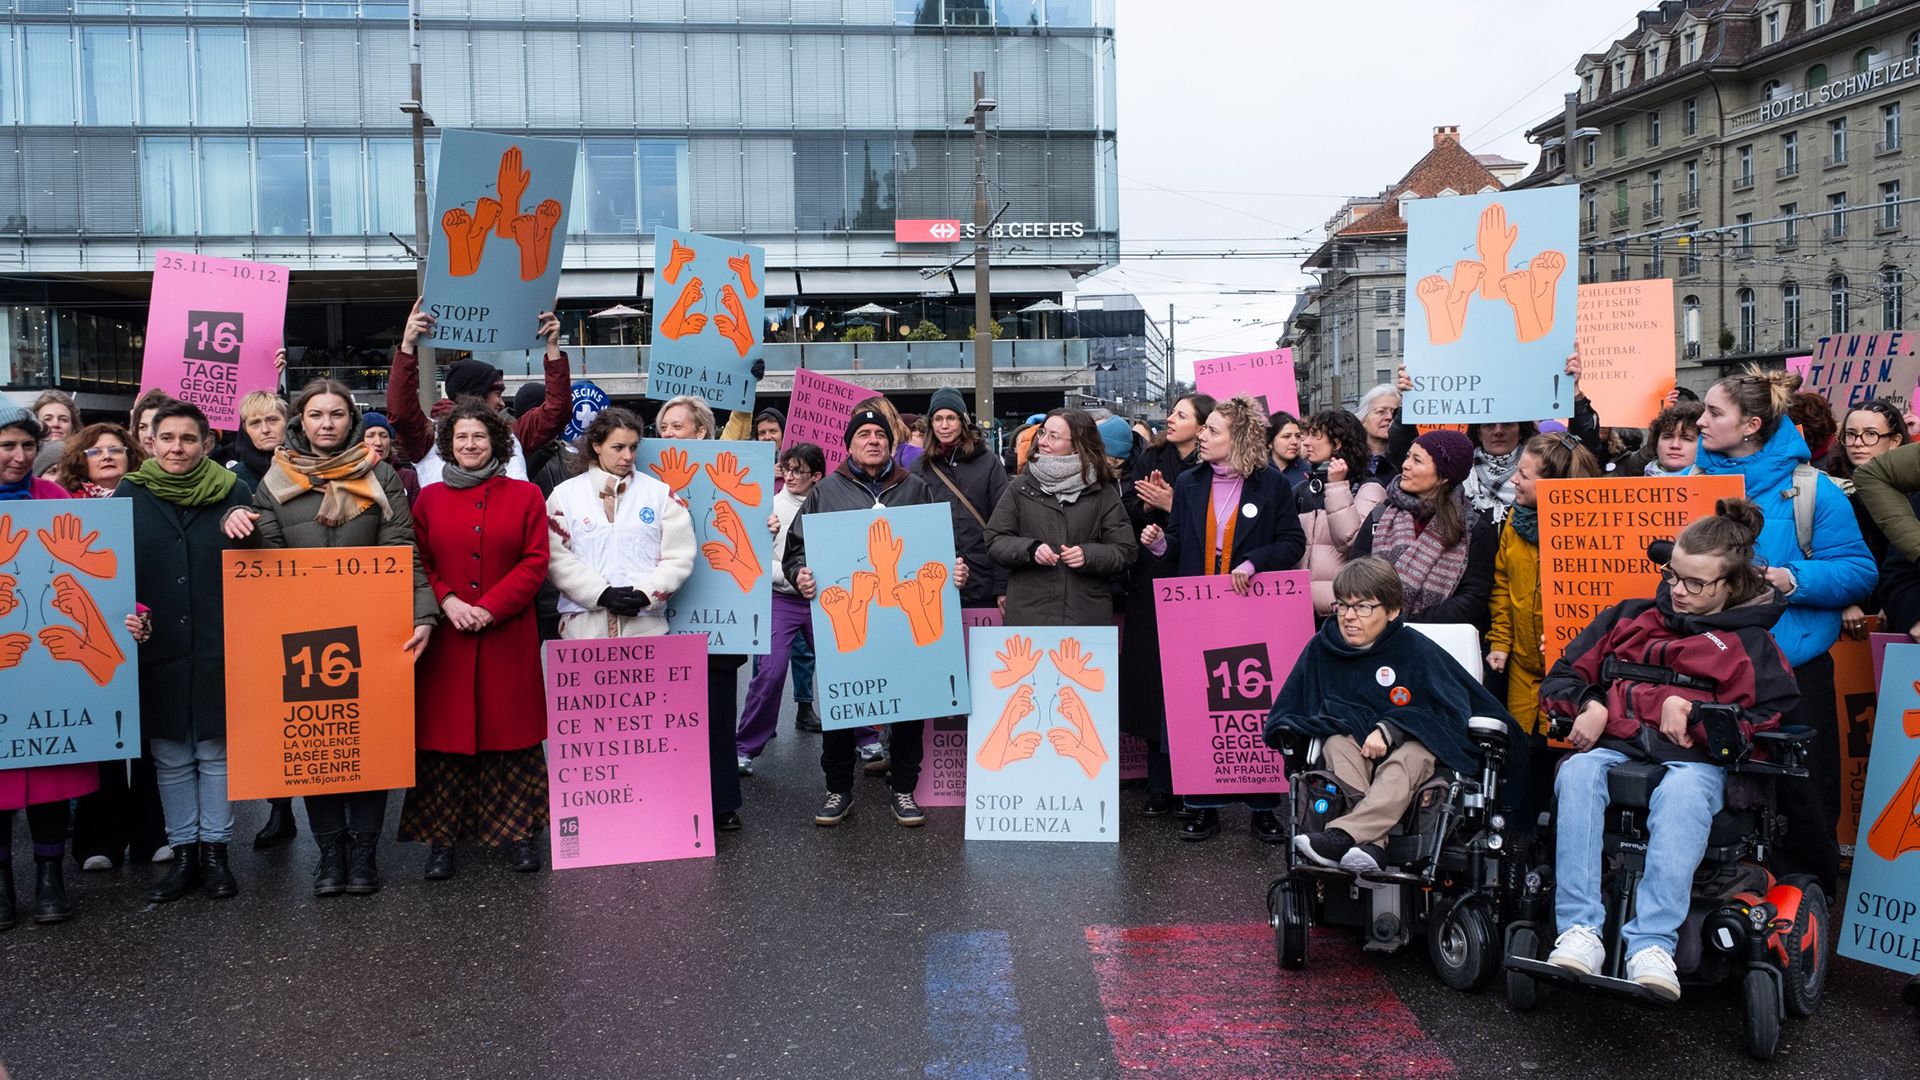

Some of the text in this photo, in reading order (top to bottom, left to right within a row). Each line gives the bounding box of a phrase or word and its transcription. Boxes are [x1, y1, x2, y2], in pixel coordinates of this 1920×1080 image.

[1760, 91, 1814, 122] HOTEL
[966, 222, 1003, 238] SB
[430, 304, 490, 322] STOPP
[1612, 310, 1635, 319] UND
[192, 320, 239, 354] 16
[429, 325, 499, 343] GEWALT
[182, 361, 239, 382] TAGE
[1580, 359, 1613, 368] DERN
[657, 363, 732, 386] STOP À LA
[1413, 375, 1481, 392] STOPP
[180, 378, 237, 395] GEGEN
[655, 380, 724, 402] VIOLENCE
[800, 375, 855, 400] VIOLENCE
[179, 391, 235, 406] GEWALT
[797, 391, 852, 416] DE GENRE
[1412, 397, 1495, 415] GEWALT
[791, 423, 806, 436] CE
[1549, 487, 1699, 505] GESCHLECHTS-
[1550, 510, 1689, 527] SPEZIFISCHE
[1551, 535, 1625, 550] GEWALT
[1554, 581, 1614, 596] NICHT
[690, 608, 737, 625] ALLA
[556, 644, 655, 664] VIOLENCE
[291, 642, 353, 687] 16
[556, 666, 692, 687] DE GENRE ET
[1212, 657, 1267, 699] 16
[828, 678, 888, 699] STOPP
[27, 707, 94, 730] ALLA
[283, 702, 360, 722] JOURS
[830, 698, 902, 721] GEWALT
[283, 721, 360, 739] CONTRE
[557, 712, 700, 735] CE N'EST PAS
[283, 737, 360, 750] LA VIOLENCE
[560, 737, 678, 759] INVISIBLE.
[1212, 734, 1268, 750] GEGE
[284, 746, 361, 763] BASÉE SUR
[933, 749, 942, 757] DI
[1213, 750, 1277, 764] GEWALT
[284, 760, 361, 777] LE GENRE
[558, 764, 620, 783] C'EST
[1215, 765, 1280, 775] AN FRAUEN
[285, 773, 361, 786] www.16jours.ch
[934, 780, 943, 789] DI
[1216, 776, 1280, 785] www.16tage.ch
[561, 784, 643, 808] IGNORÉ.
[975, 795, 1084, 811] STOP ALLA
[561, 820, 578, 834] 16
[975, 817, 1071, 833] VIOLENZA
[1857, 891, 1917, 924] STOP
